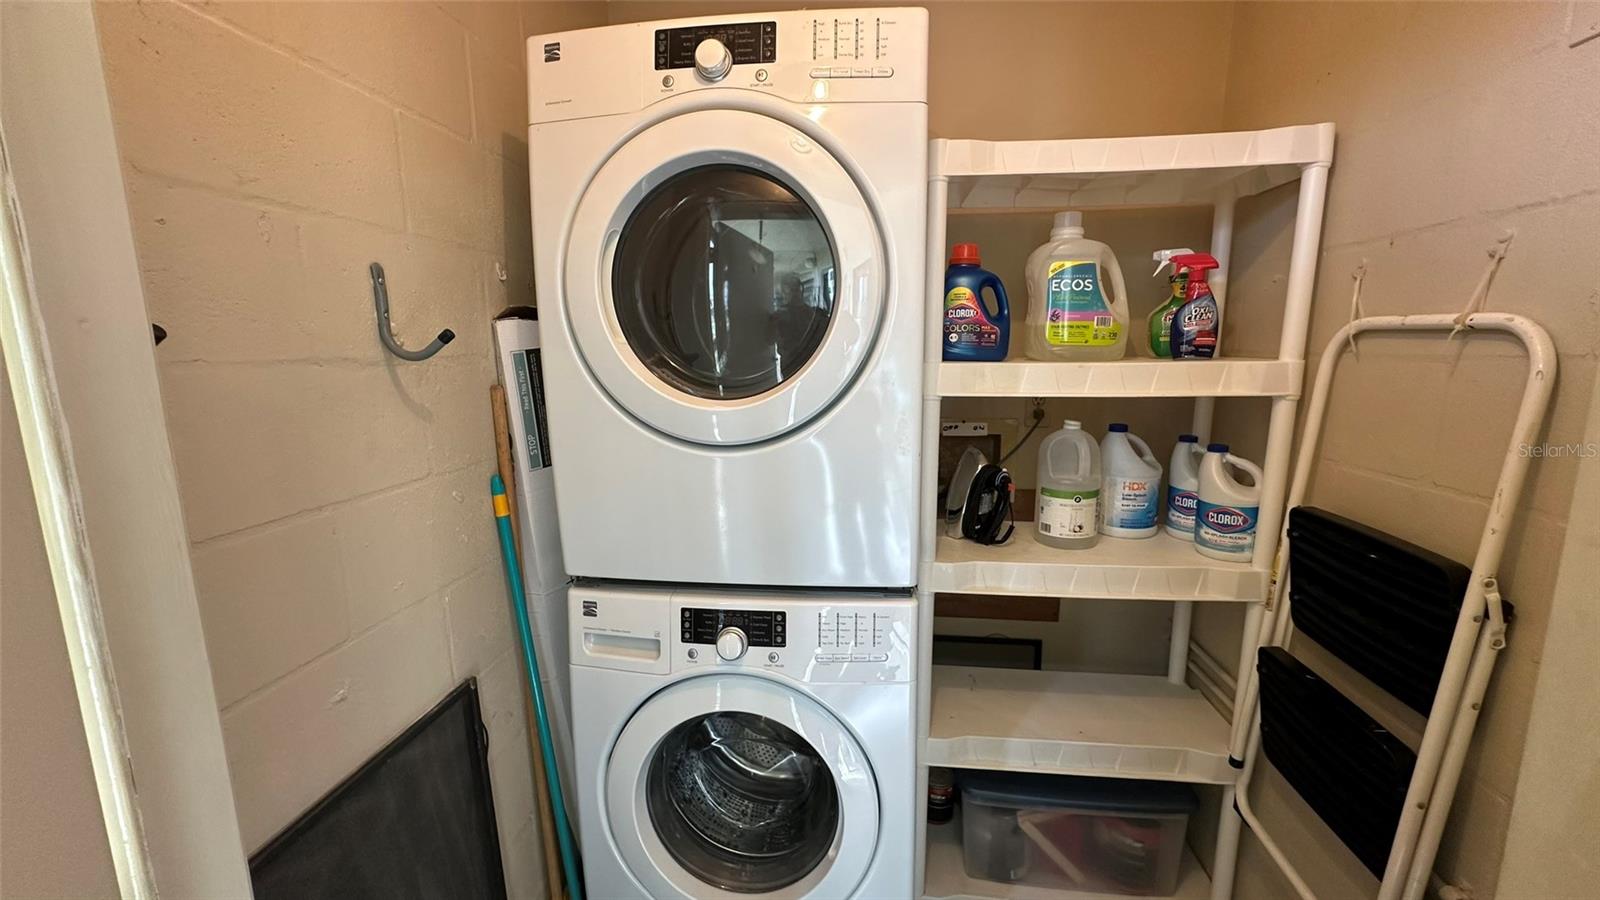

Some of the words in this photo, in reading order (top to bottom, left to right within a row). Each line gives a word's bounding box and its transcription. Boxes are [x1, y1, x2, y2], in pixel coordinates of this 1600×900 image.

[1051, 279, 1093, 292] ECOS
[1191, 305, 1209, 316] OXI
[1185, 312, 1213, 323] CLEAN
[944, 324, 980, 333] COLORS
[528, 434, 538, 456] STOP
[1123, 482, 1147, 491] HDX
[1175, 496, 1198, 509] CLORO
[1208, 512, 1244, 526] CLOROX
